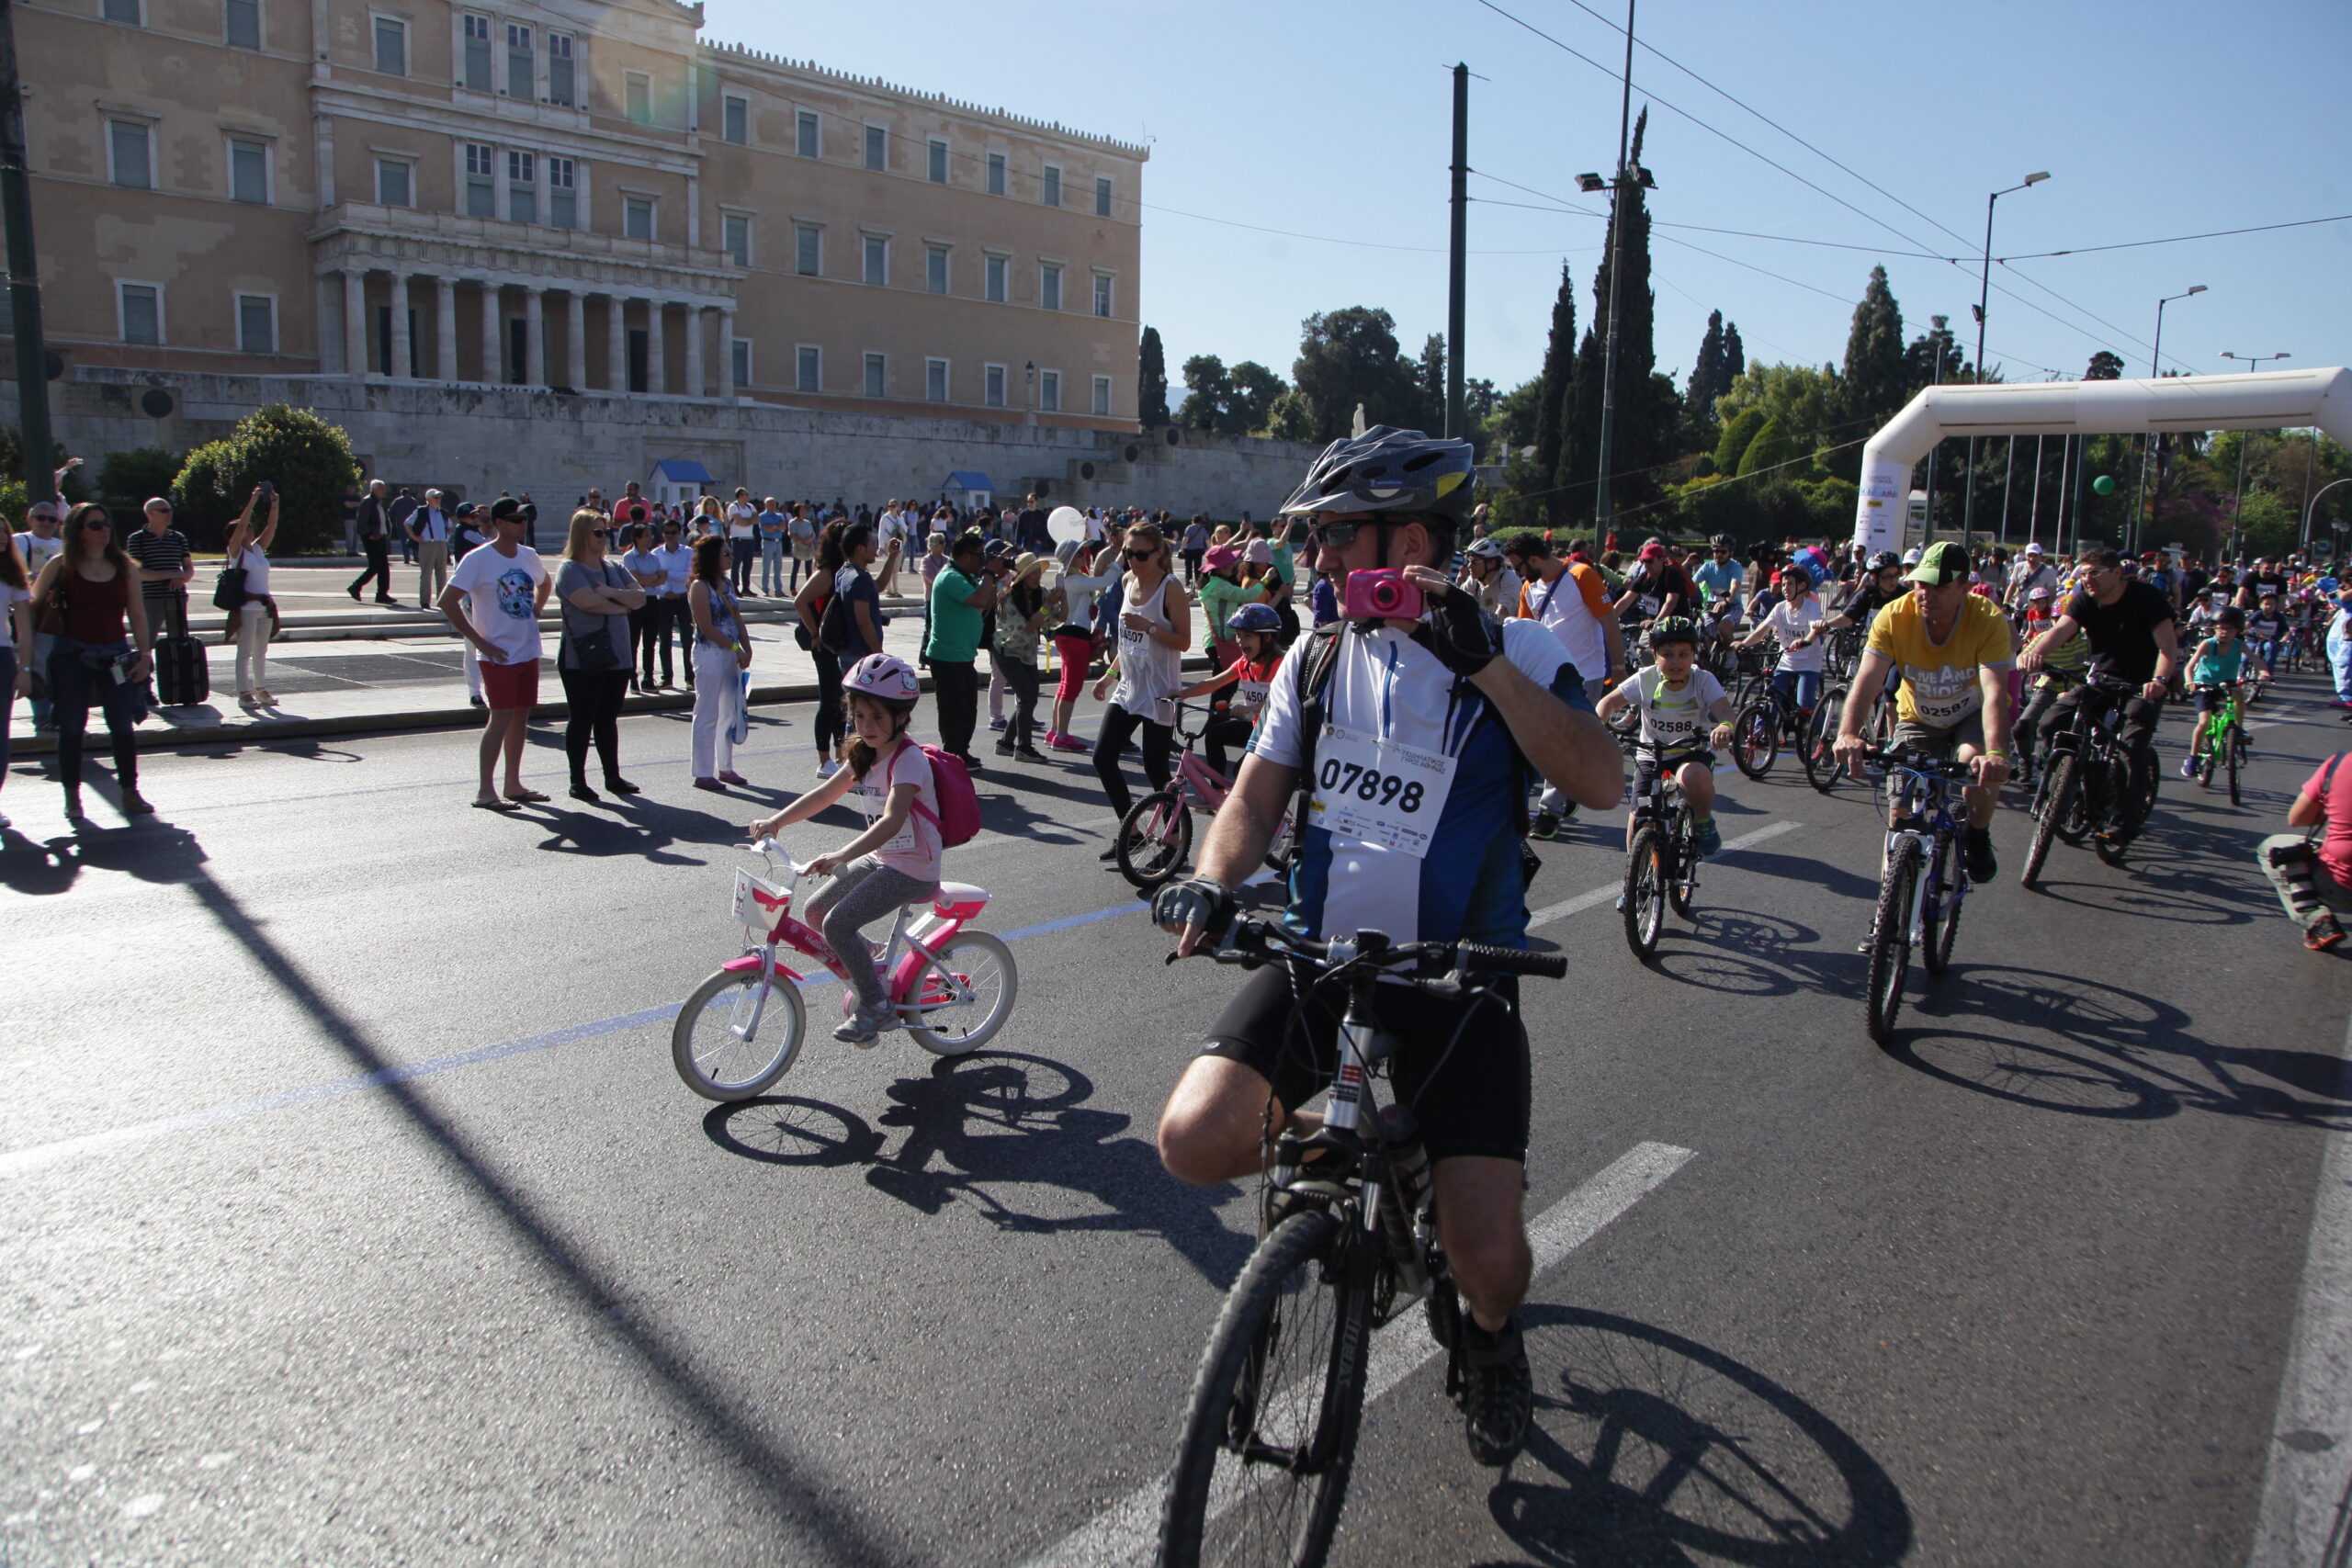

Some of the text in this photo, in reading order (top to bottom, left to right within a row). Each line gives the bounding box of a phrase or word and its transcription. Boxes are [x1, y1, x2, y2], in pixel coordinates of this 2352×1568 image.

[1920, 696, 1971, 717] 02587
[1650, 718, 1692, 733] 02588
[1319, 758, 1425, 814] 07898
